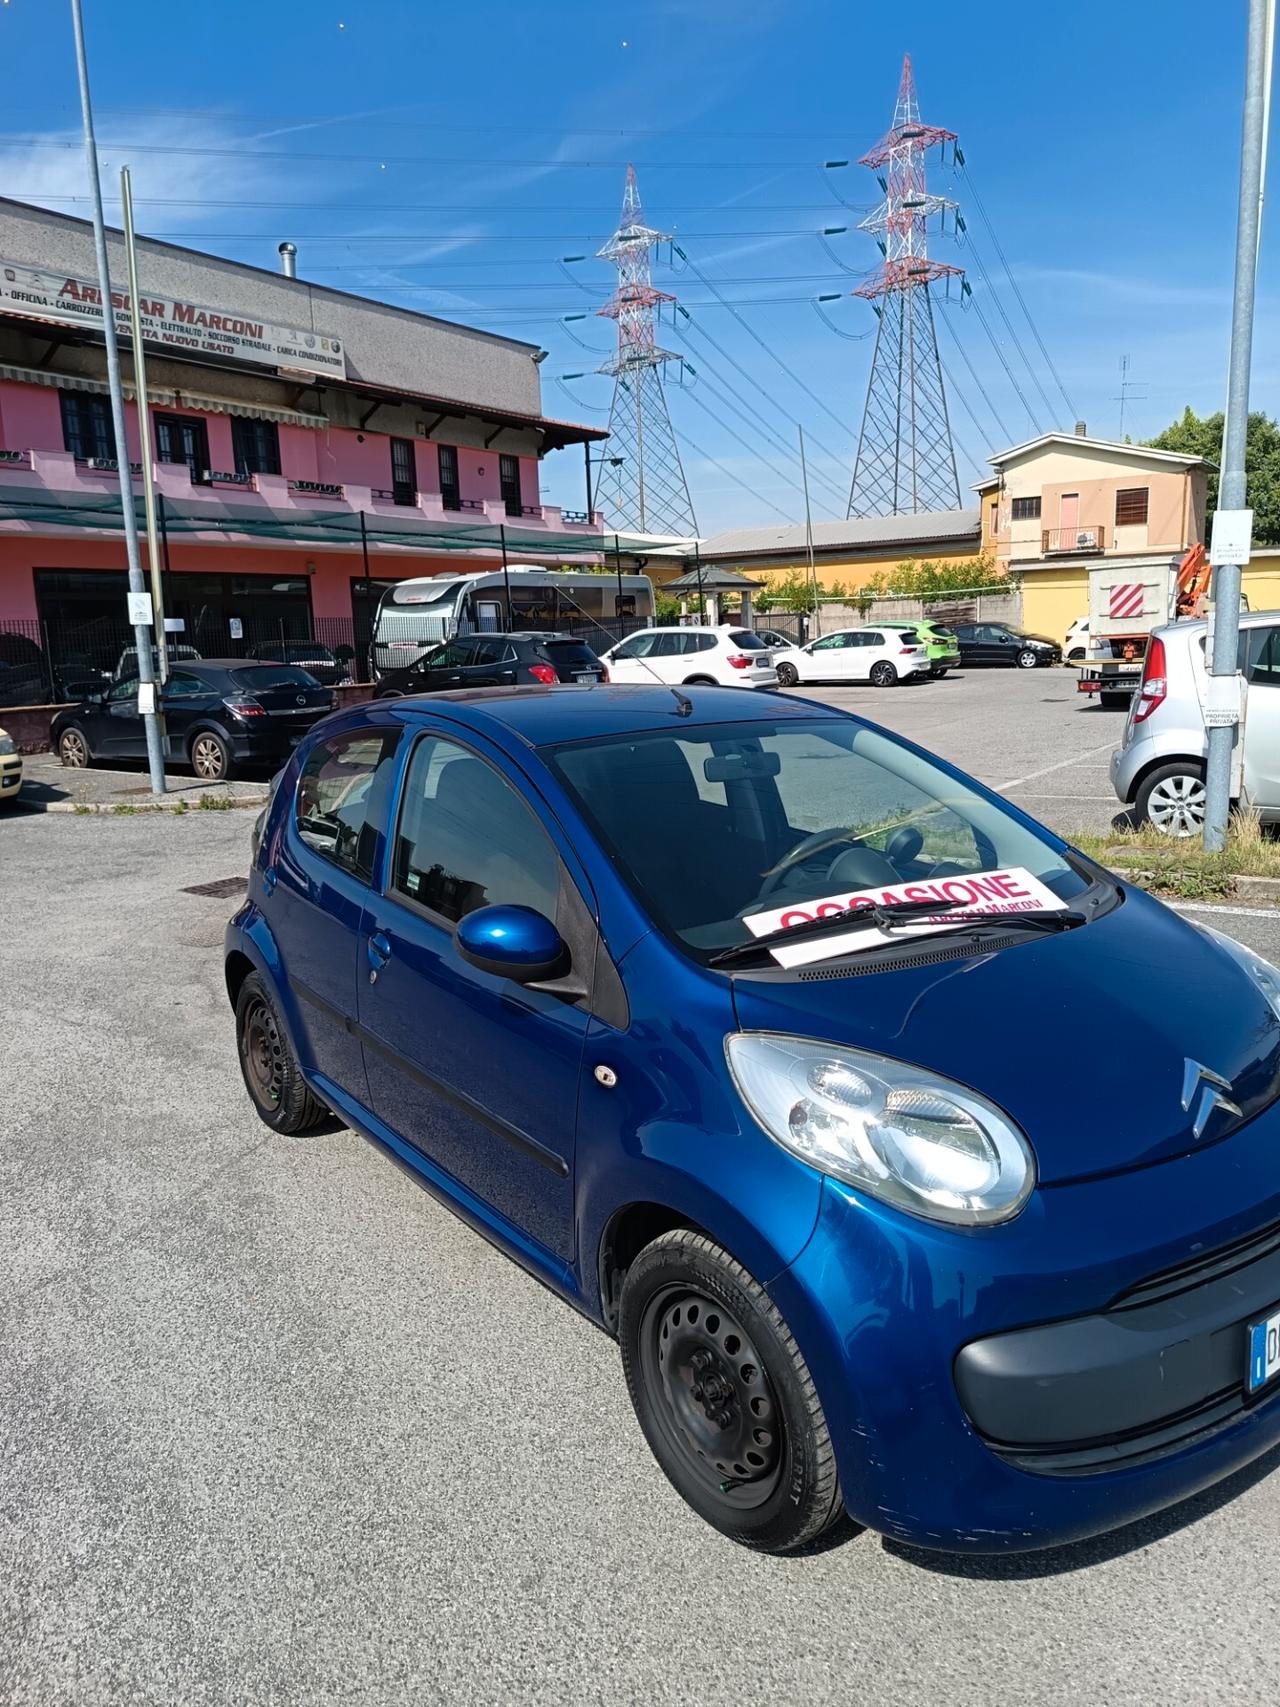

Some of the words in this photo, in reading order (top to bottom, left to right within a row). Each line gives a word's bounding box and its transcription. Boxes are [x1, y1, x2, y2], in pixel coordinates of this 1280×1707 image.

[11, 290, 48, 306] OFFICINA
[56, 300, 104, 318] CARROZZERI
[115, 312, 154, 328] GOMSTA
[160, 321, 202, 338] ELETTRAUTO
[208, 331, 240, 345] SOCCORSO
[242, 338, 272, 353] STRADALE
[276, 346, 298, 358] CARICA
[172, 302, 263, 339] MARCONI
[115, 324, 159, 340] VENITA
[161, 333, 199, 348] NUOVO
[201, 341, 234, 355] USATO
[985, 899, 1043, 914] MARCONI
